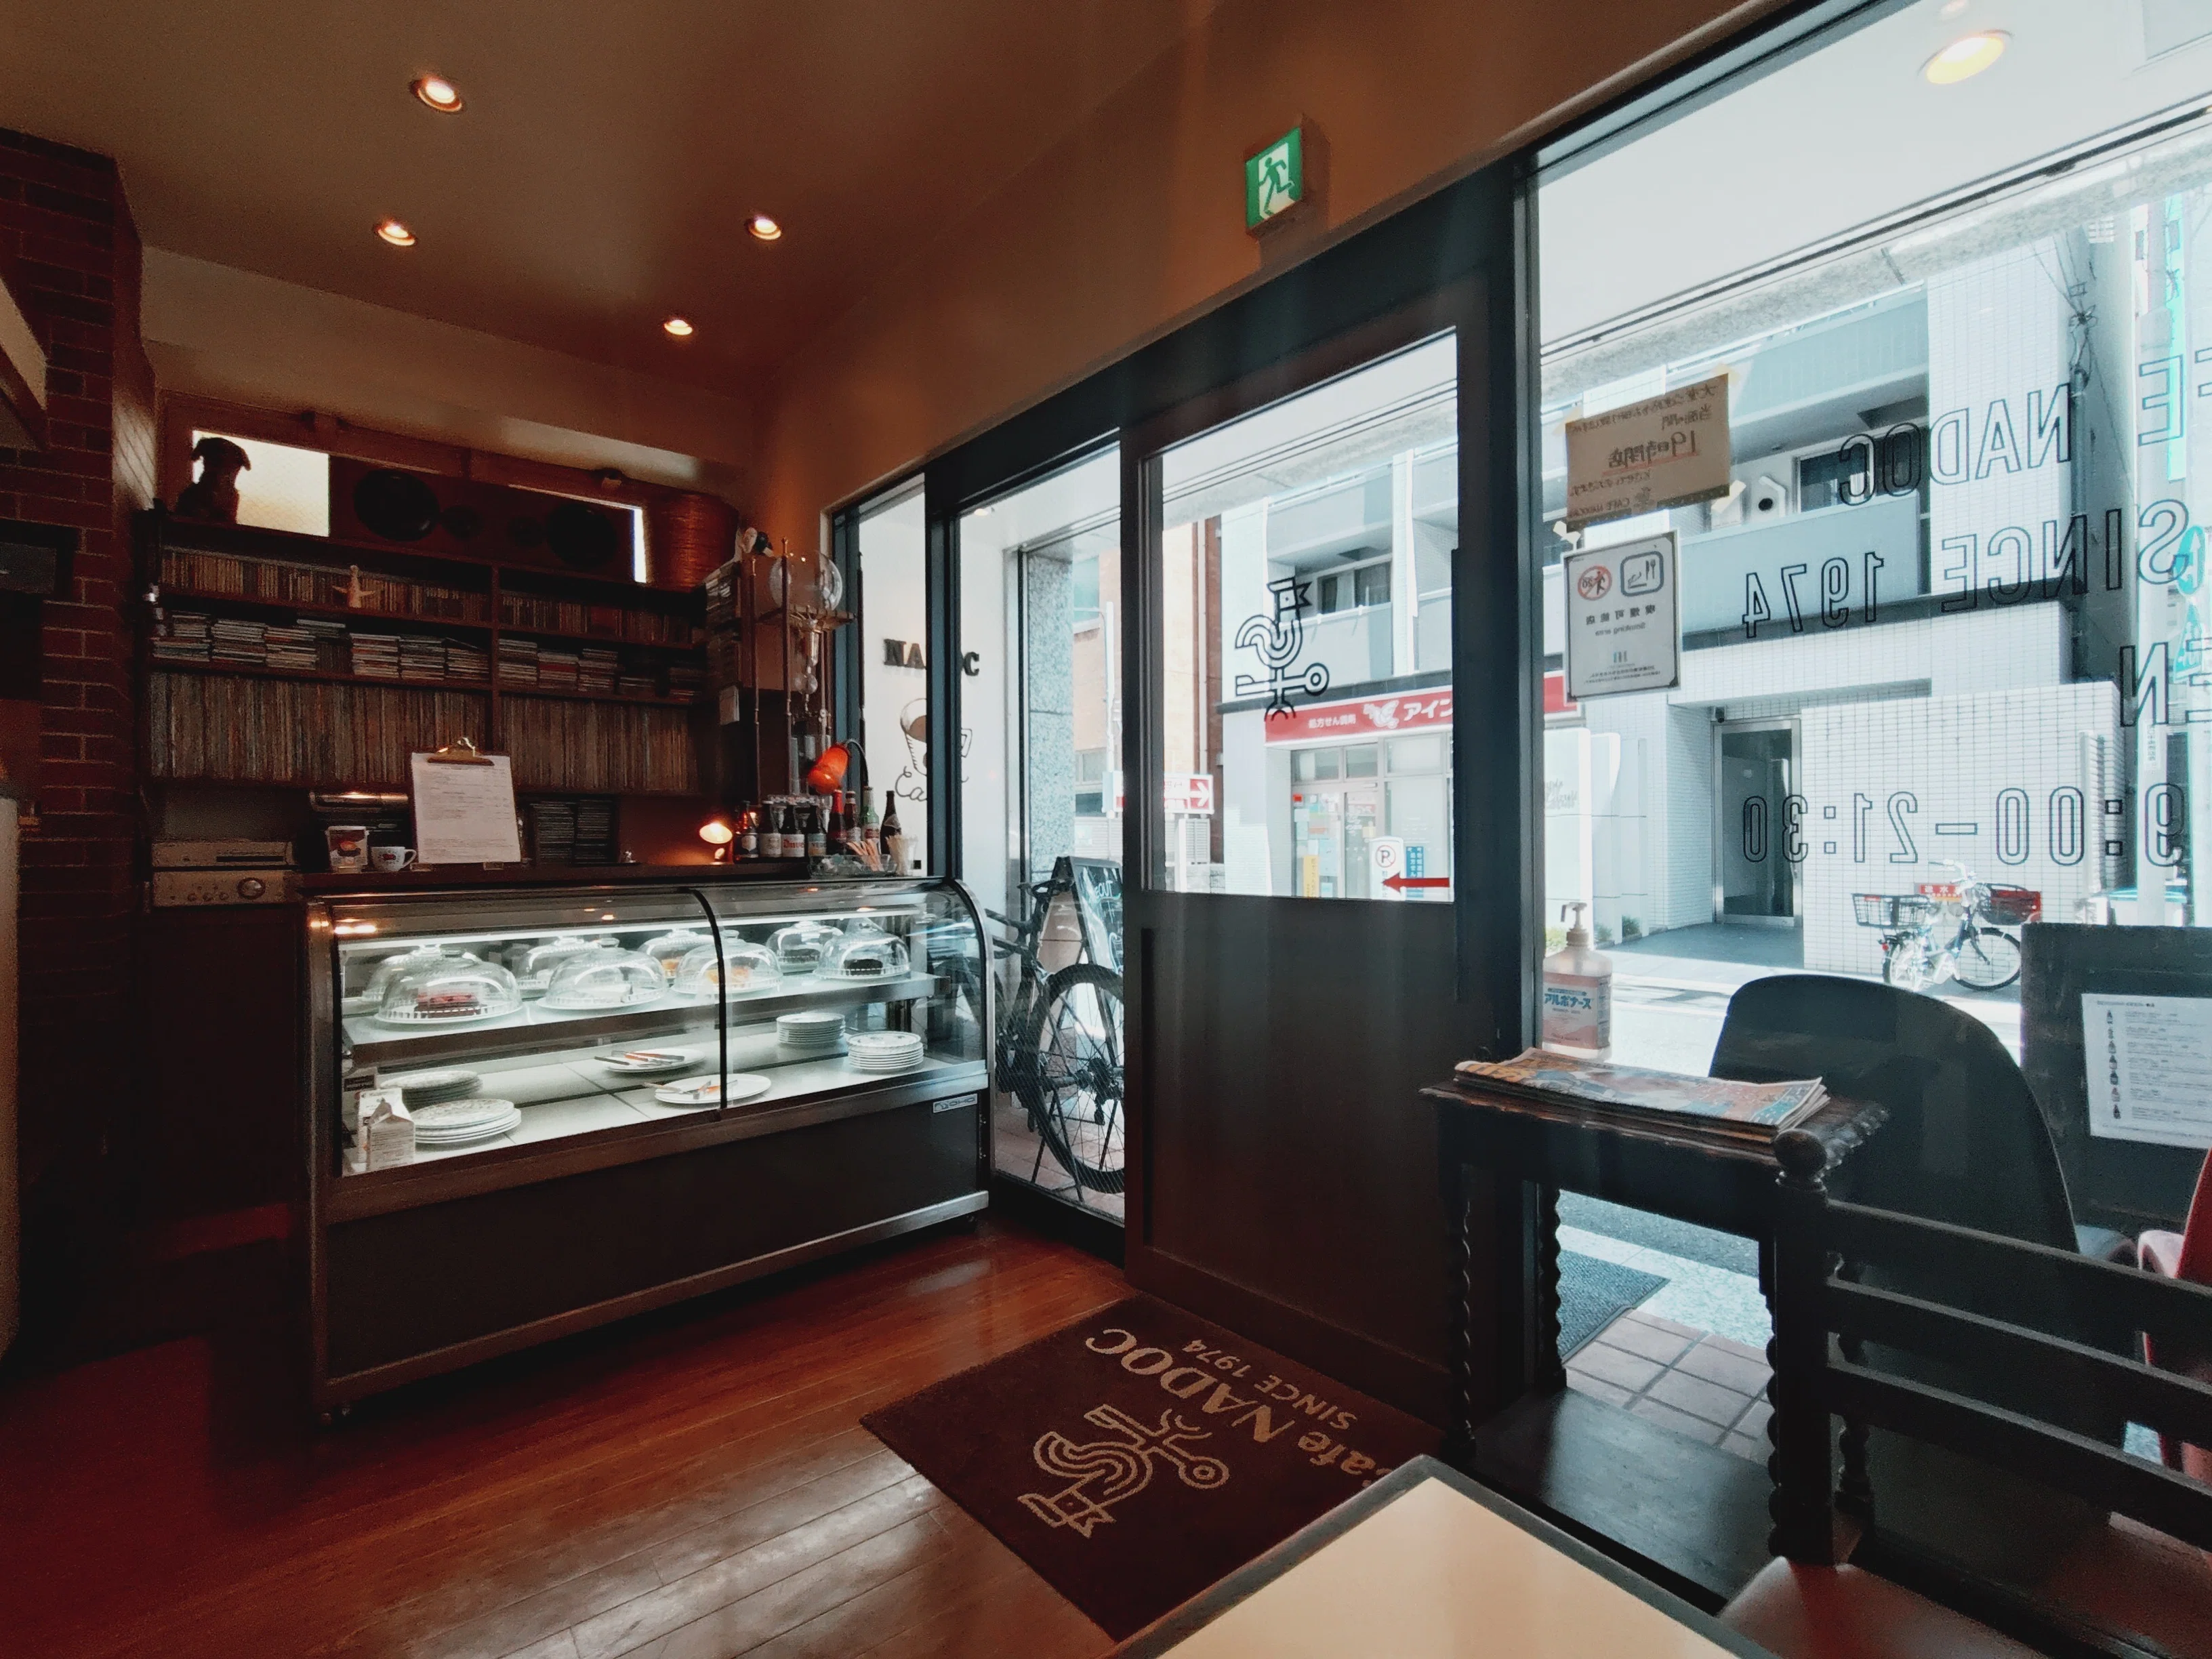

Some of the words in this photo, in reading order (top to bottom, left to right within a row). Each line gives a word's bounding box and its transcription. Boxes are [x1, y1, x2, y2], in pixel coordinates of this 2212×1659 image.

[1085, 1328, 1295, 1442] NADOC
[1181, 1339, 1252, 1379] 1974
[1254, 1373, 1358, 1431] SINCE
[1297, 1431, 1392, 1488] afe
